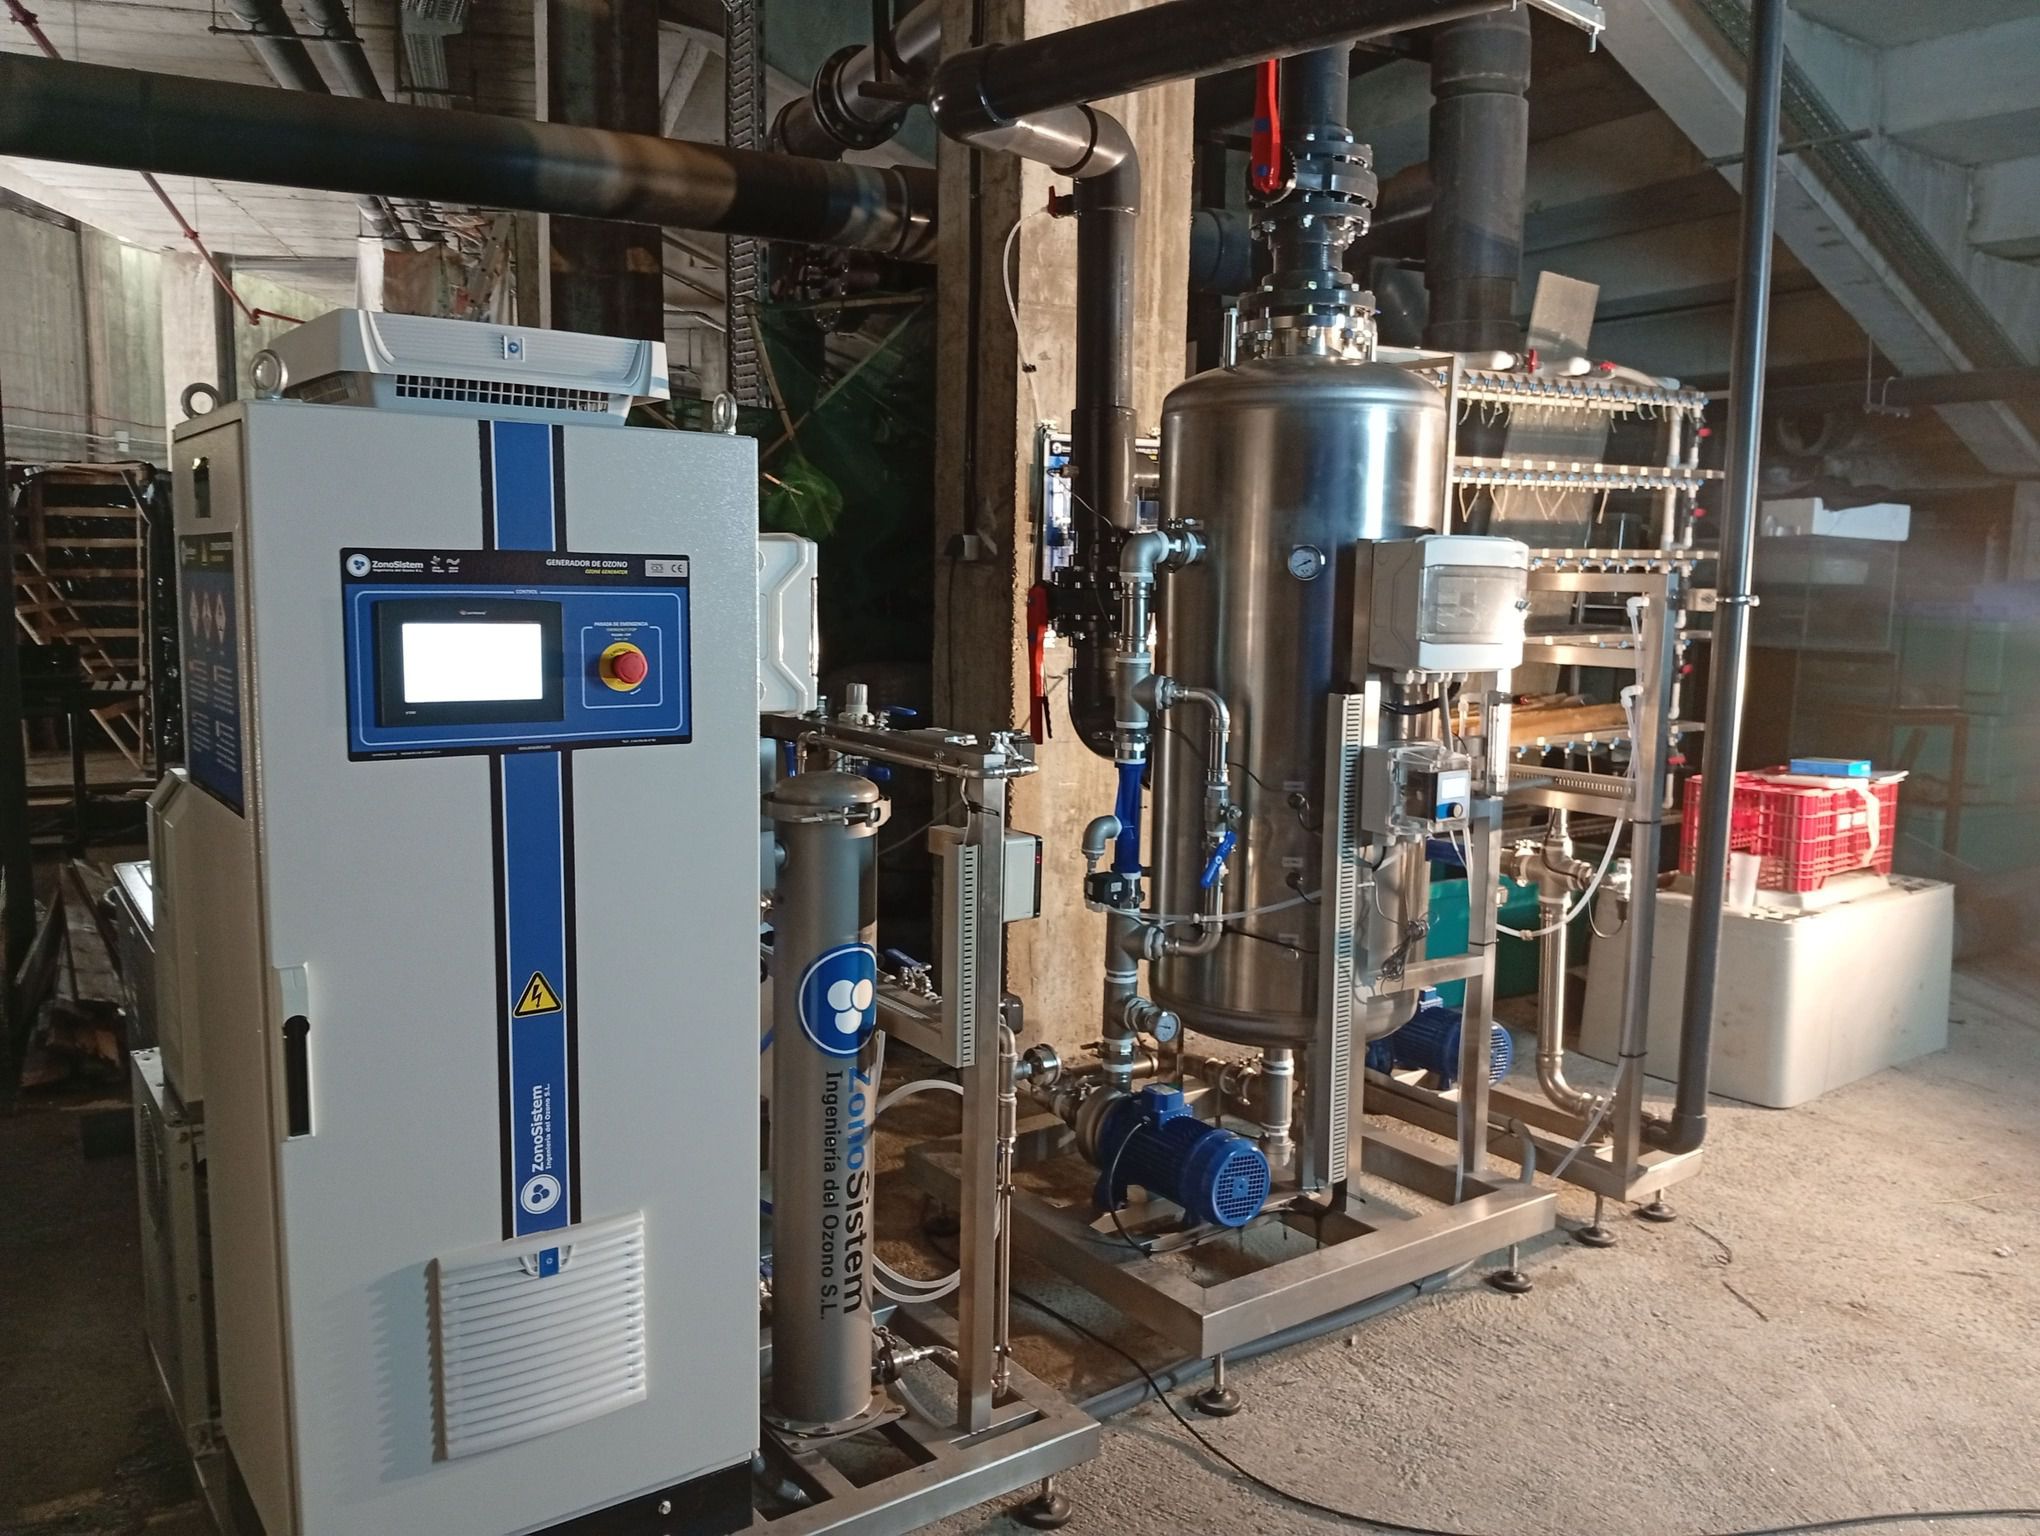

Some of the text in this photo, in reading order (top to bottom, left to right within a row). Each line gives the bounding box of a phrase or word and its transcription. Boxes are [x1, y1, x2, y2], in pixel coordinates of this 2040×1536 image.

[371, 560, 424, 569] ZonoSistem
[546, 558, 591, 567] GENERADOR
[602, 560, 628, 568] OZONO
[531, 1085, 544, 1172] ZonoSistem
[820, 1071, 843, 1320] Ingeniería del Ozono S.L.
[843, 1066, 870, 1314] ZonoSistem
